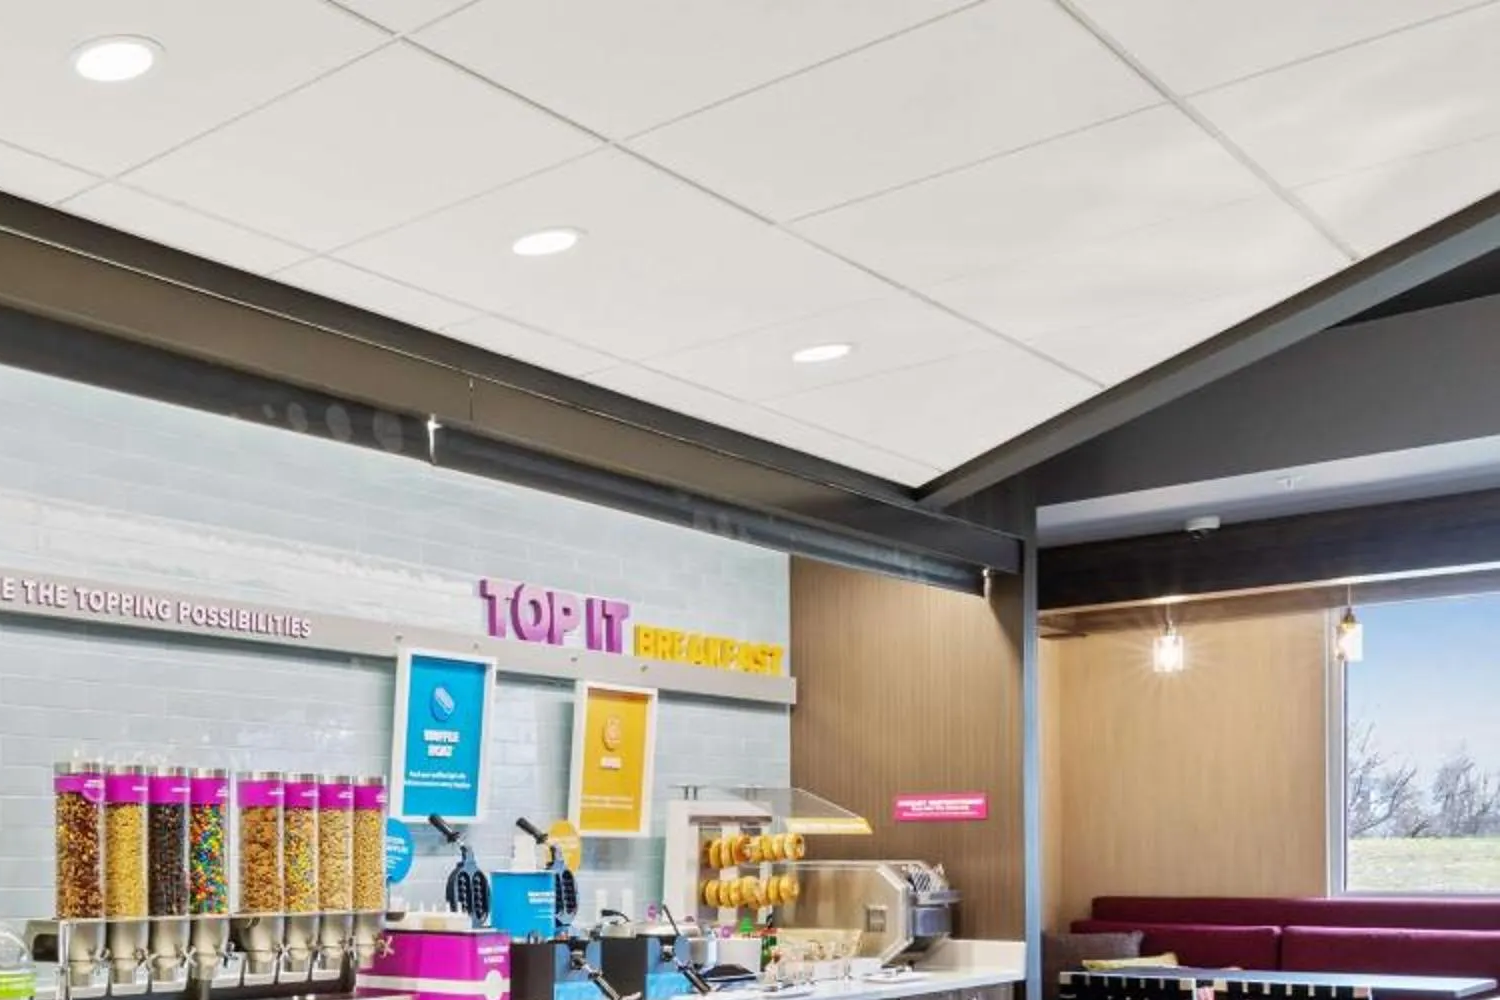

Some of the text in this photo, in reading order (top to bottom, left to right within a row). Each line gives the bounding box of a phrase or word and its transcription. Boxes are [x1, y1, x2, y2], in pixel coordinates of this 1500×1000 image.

[22, 579, 69, 609] THE
[74, 586, 172, 621] TOPPING
[177, 601, 312, 638] POSSIBILITIES
[479, 579, 784, 675] TOP IT BREAKFAST
